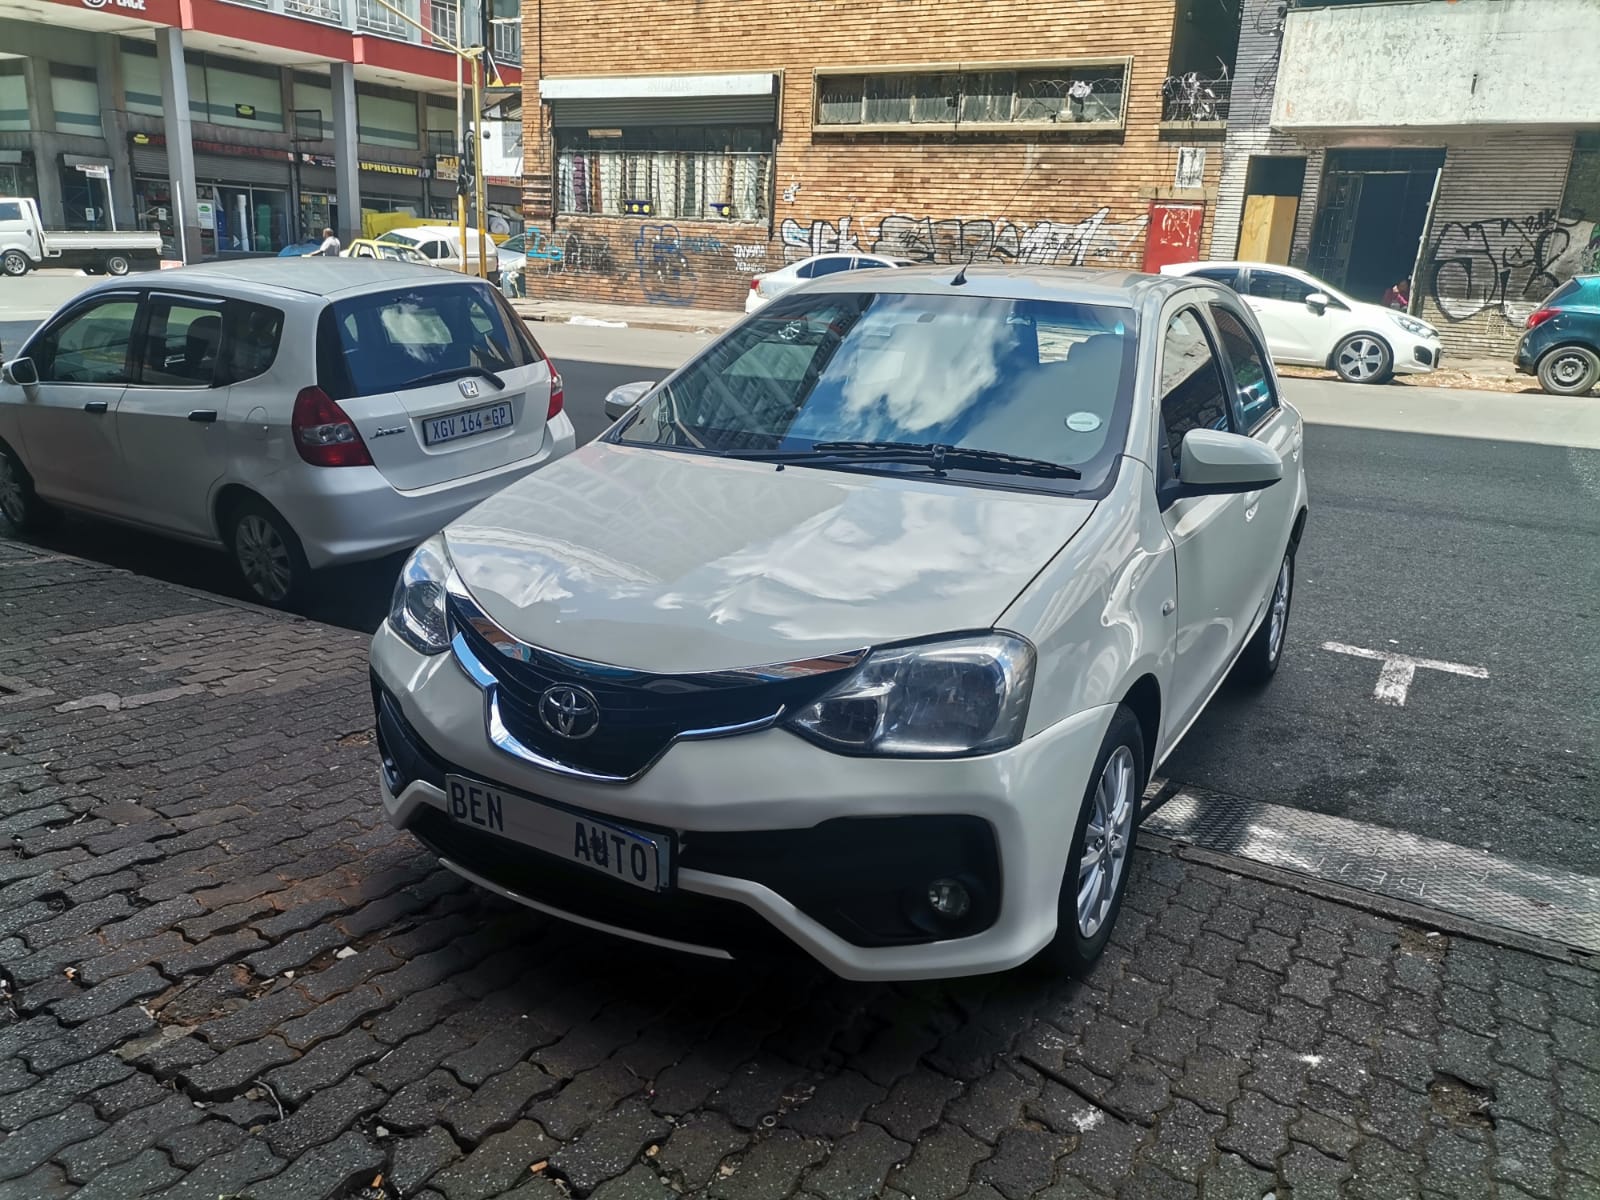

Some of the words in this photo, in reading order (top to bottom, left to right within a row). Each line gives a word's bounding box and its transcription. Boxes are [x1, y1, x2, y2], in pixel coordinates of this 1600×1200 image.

[361, 162, 418, 176] UPHOLSTERY
[432, 418, 455, 440] XGV
[460, 413, 482, 433] 164
[491, 407, 505, 426] GP
[451, 782, 503, 832] BEN
[574, 822, 648, 881] AUTO
